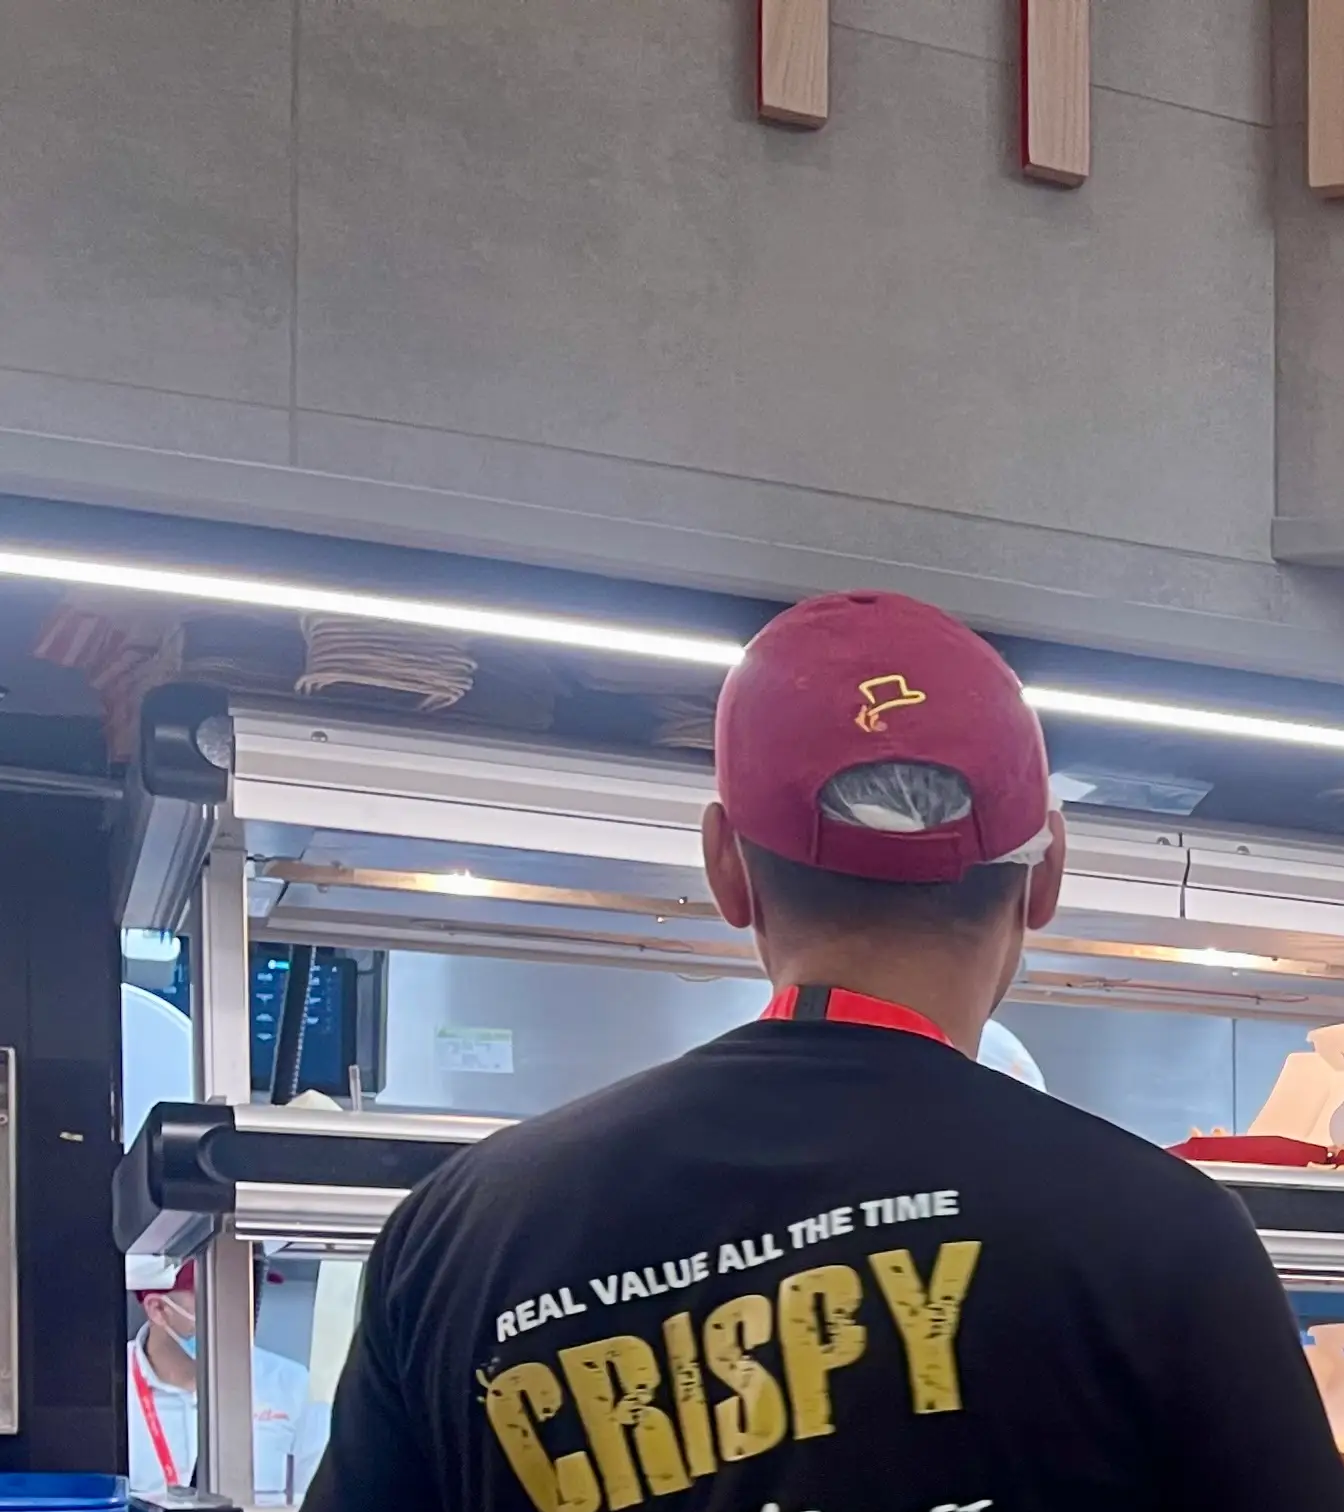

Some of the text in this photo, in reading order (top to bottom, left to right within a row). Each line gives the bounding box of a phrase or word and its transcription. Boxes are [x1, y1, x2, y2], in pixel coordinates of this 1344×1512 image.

[497, 1190, 959, 1341] REAL VALUE ALL THE TIME
